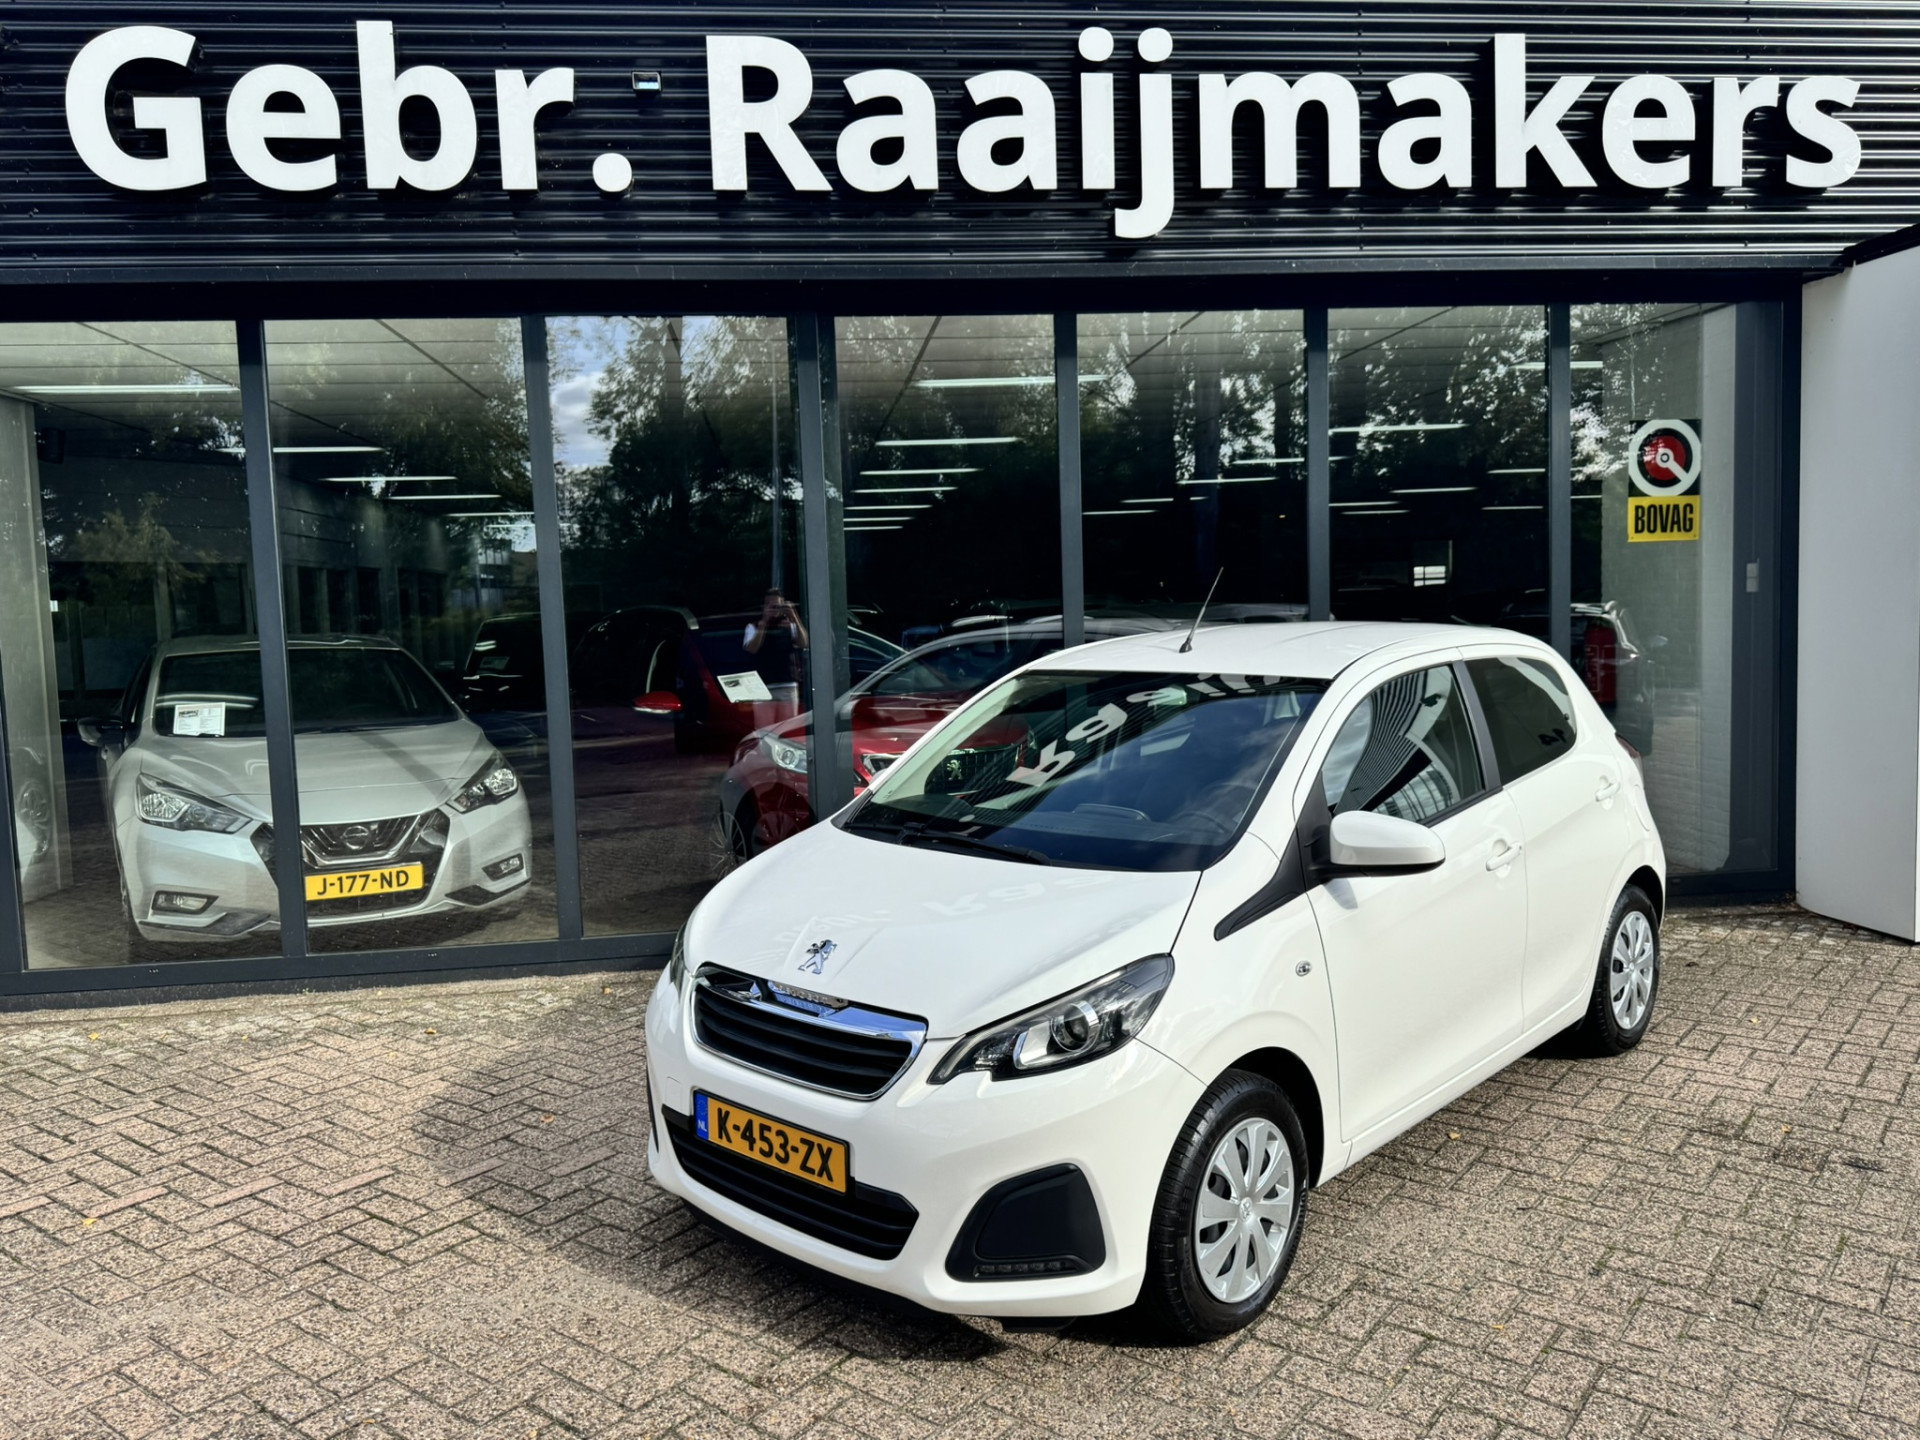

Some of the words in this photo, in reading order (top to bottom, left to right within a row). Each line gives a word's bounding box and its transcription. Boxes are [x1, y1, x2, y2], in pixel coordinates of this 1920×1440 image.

[65, 20, 632, 192] Gebr.
[706, 27, 1862, 239] Raaijmakers
[1634, 503, 1694, 534] BOVAG
[317, 869, 410, 896] J-177-ND
[697, 1119, 708, 1132] NL
[717, 1107, 834, 1183] K-453-ZX
